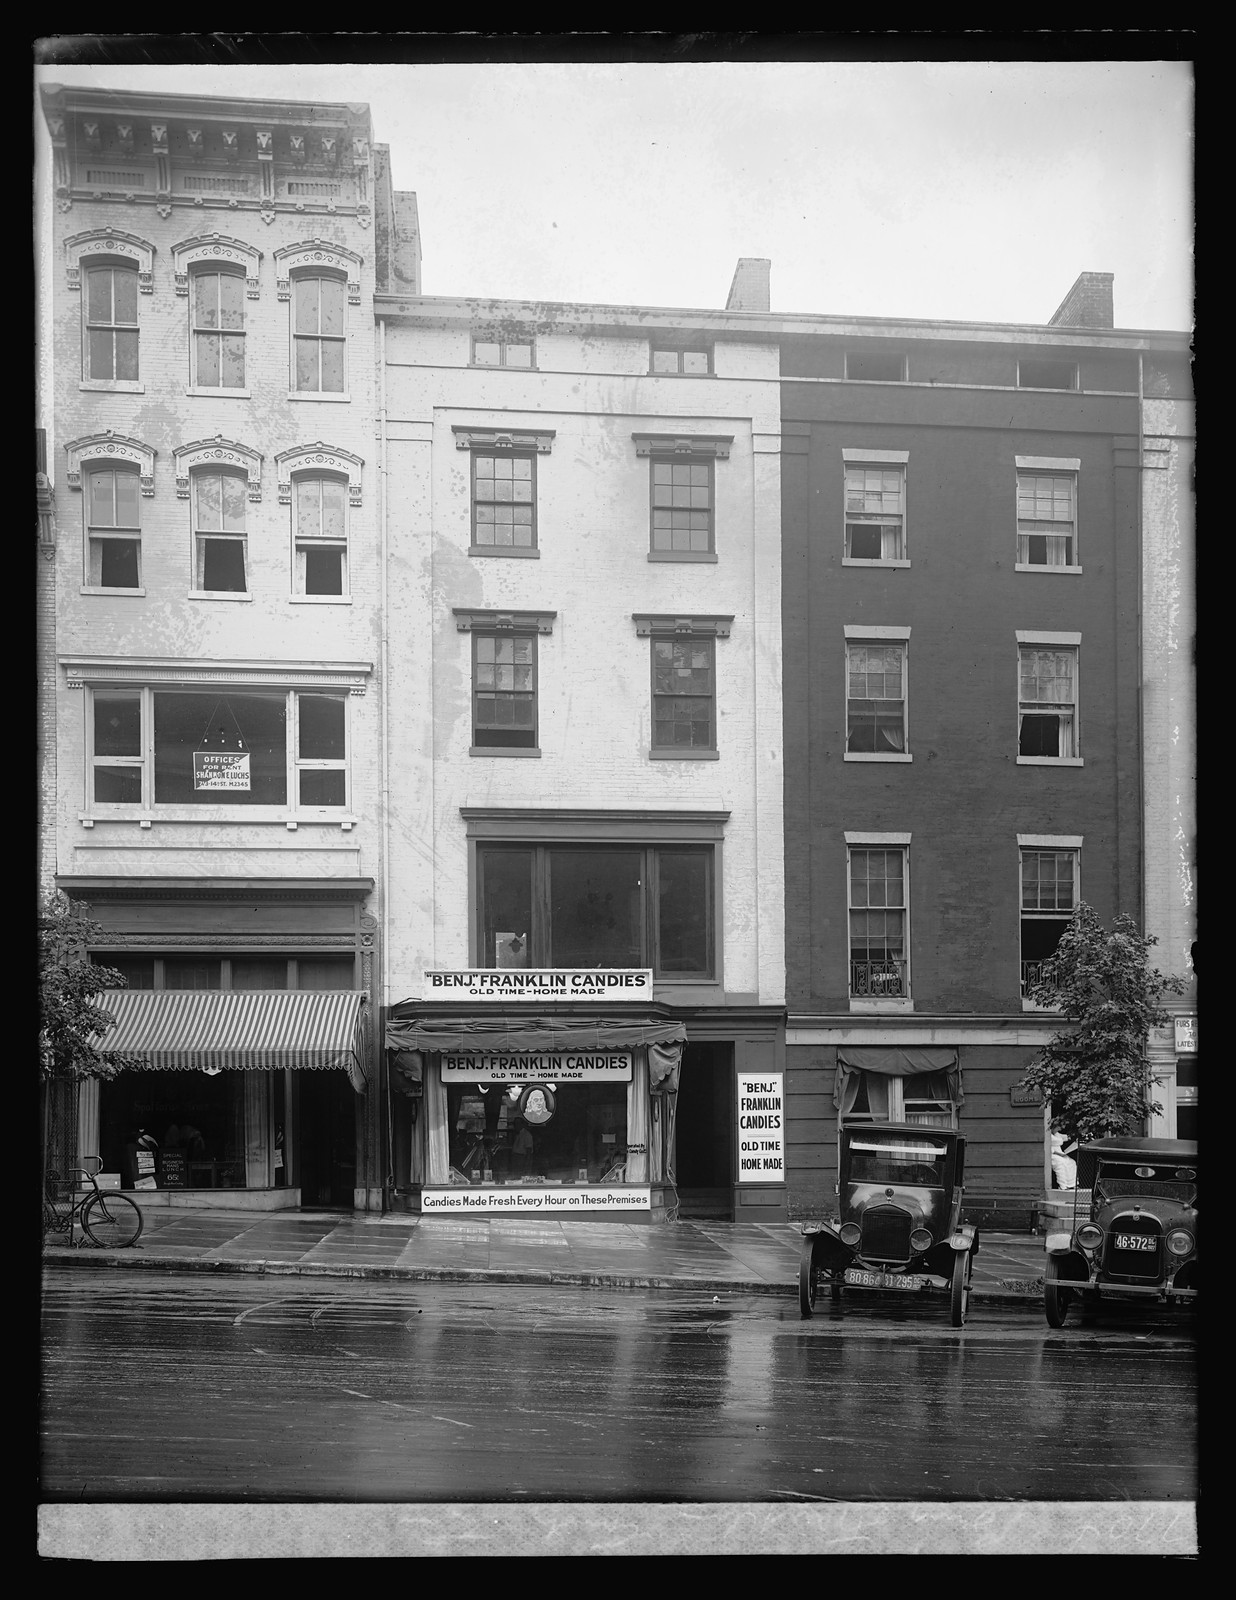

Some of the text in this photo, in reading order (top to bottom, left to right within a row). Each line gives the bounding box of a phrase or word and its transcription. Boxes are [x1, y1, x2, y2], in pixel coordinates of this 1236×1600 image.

[230, 771, 249, 779] LUCHS
[480, 975, 566, 987] FRANKLIN
[571, 975, 646, 987] CANDIES
[1177, 1040, 1197, 1048] LATEST
[490, 1056, 562, 1070] FRANKLIN
[566, 1056, 628, 1070] CANDIES
[741, 1097, 781, 1111] FRANKLIN
[740, 1115, 781, 1129] CANDIES
[741, 1141, 781, 1151] OLD TIME
[741, 1158, 783, 1170] HOME MADE
[423, 1193, 648, 1208] Candies Made Fresh Every Hour on These Premises
